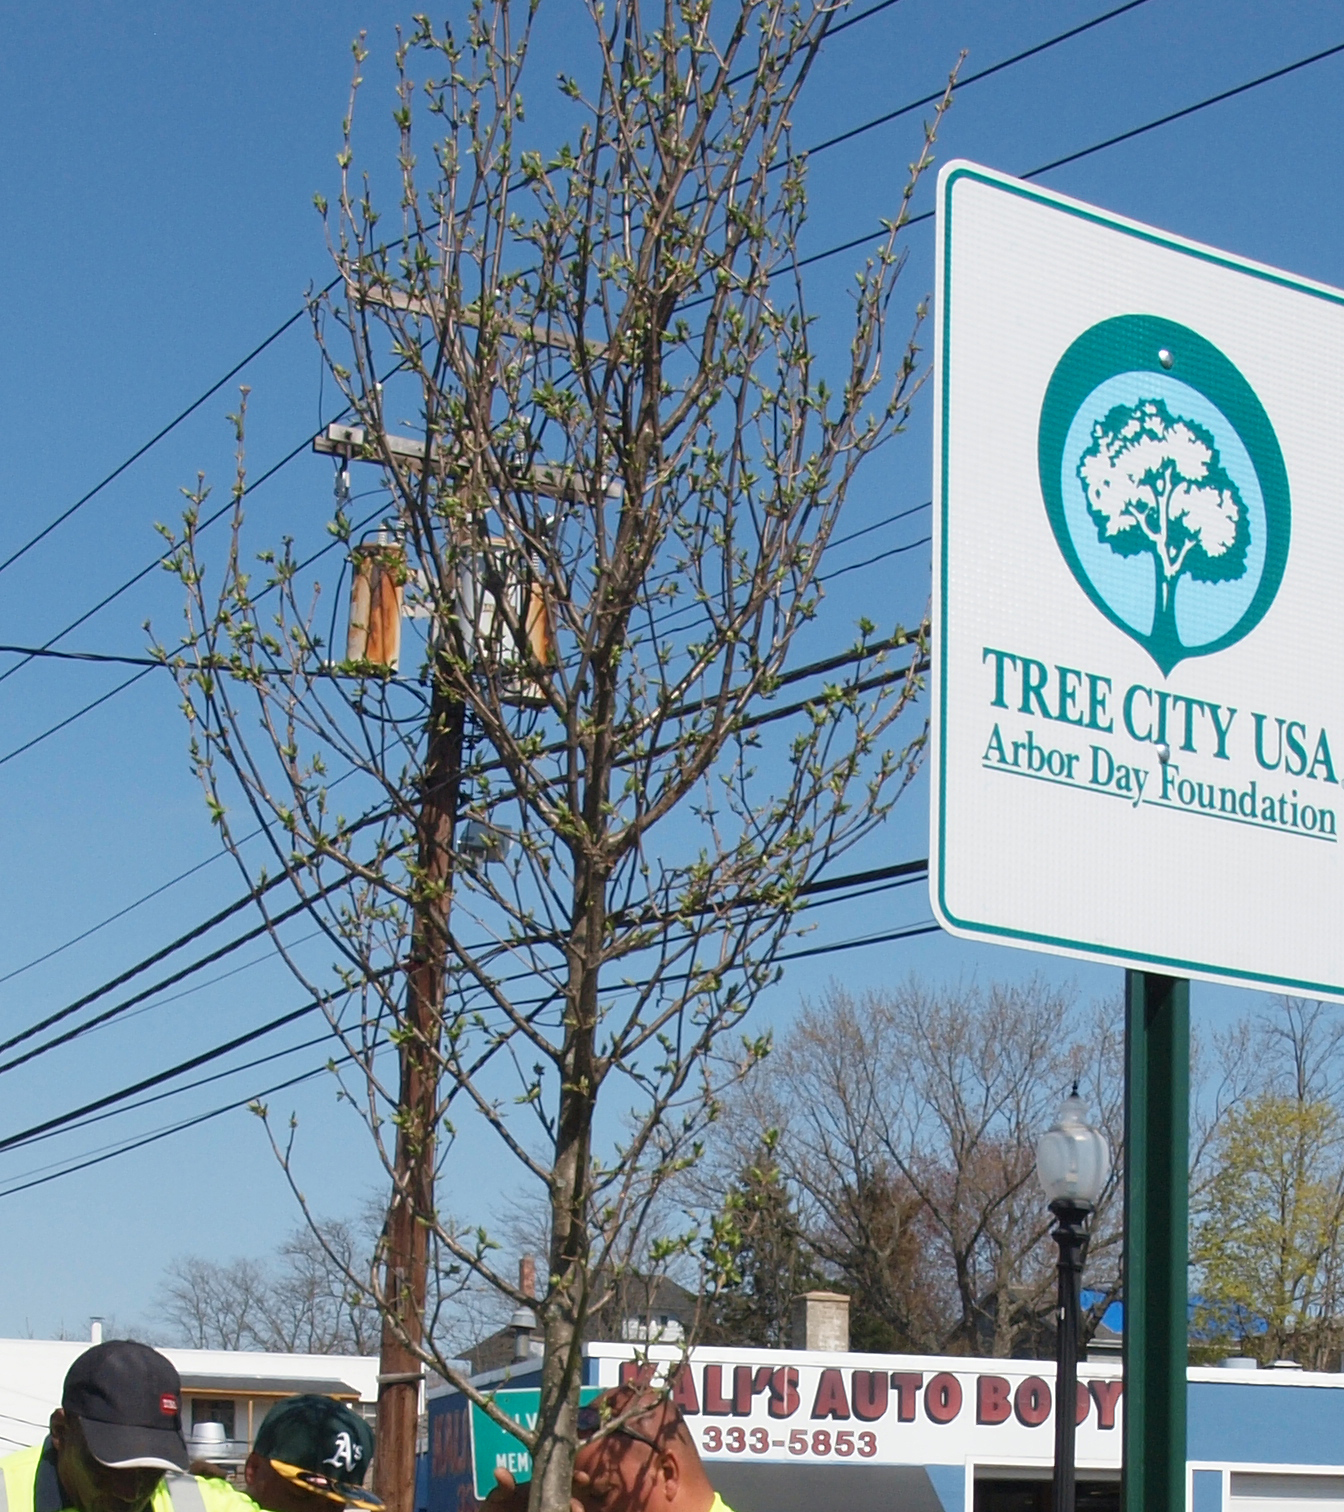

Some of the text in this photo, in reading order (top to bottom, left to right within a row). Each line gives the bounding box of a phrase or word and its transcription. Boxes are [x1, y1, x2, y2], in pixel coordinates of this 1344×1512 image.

[982, 646, 1339, 784] TREE CITY USA
[982, 722, 1337, 836] Arbor Day Foundation
[810, 1368, 963, 1425] AUTO
[322, 1431, 363, 1473] A's
[702, 1425, 878, 1458] 333-5853
